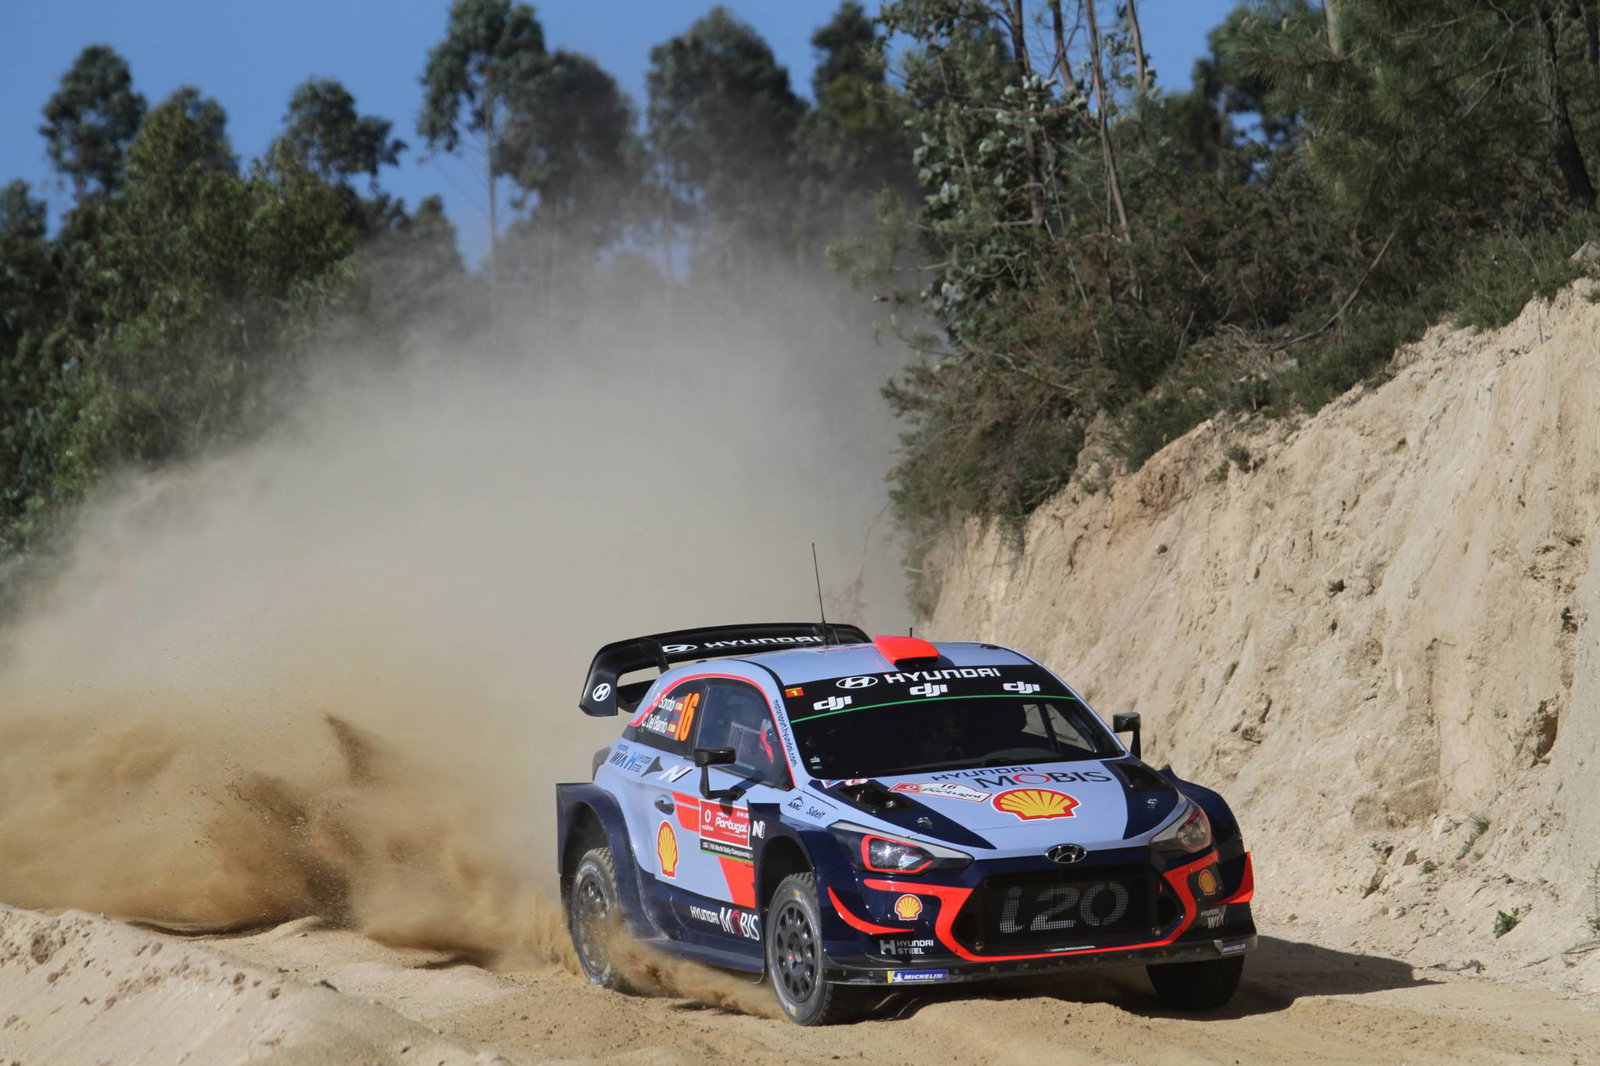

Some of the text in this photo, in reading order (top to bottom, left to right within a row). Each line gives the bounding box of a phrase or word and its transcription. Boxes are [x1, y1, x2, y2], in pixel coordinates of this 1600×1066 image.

[704, 636, 822, 648] HYUNDAI
[883, 667, 1001, 684] HYUNDAI
[674, 693, 700, 741] 16
[773, 699, 798, 768] motorsport.hyundai.com
[931, 766, 1035, 781] HYUNDAI
[973, 771, 1112, 789] MOBIS
[922, 787, 982, 800] Portugal
[715, 816, 748, 834] Portugal
[1000, 881, 1128, 933] i20
[689, 905, 760, 941] HYUNDAI MOBIS
[897, 939, 934, 947] HYUNDAI
[898, 947, 925, 955] STEEL
